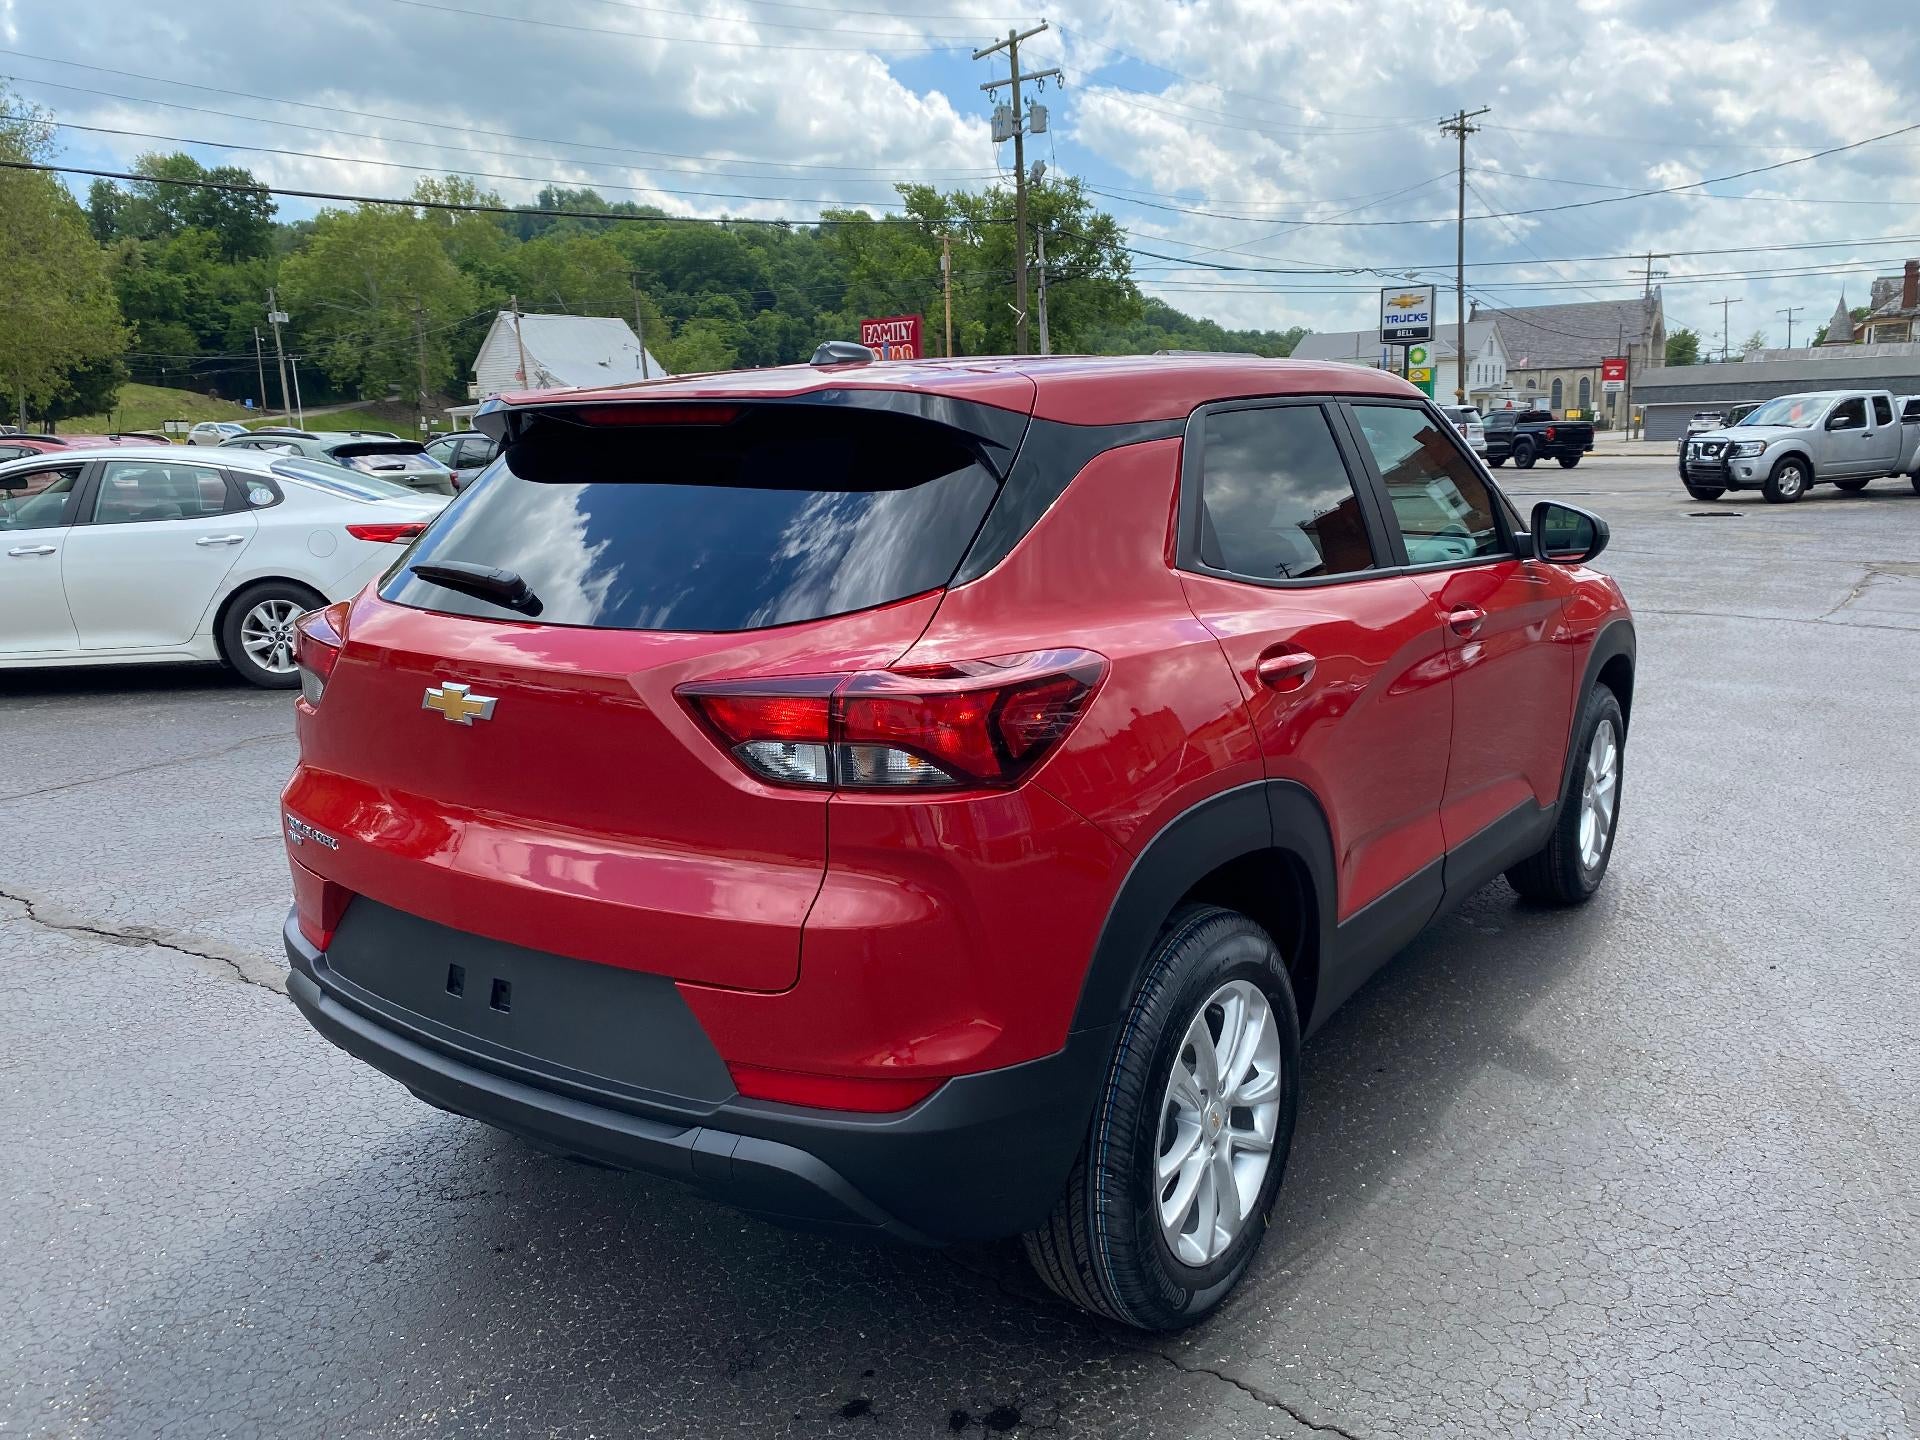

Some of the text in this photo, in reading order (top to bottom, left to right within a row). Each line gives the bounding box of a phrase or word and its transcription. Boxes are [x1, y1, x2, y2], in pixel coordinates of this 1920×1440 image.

[1384, 312, 1428, 324] TRUCKS
[863, 321, 914, 344] FAMILY
[1396, 329, 1414, 337] BELL
